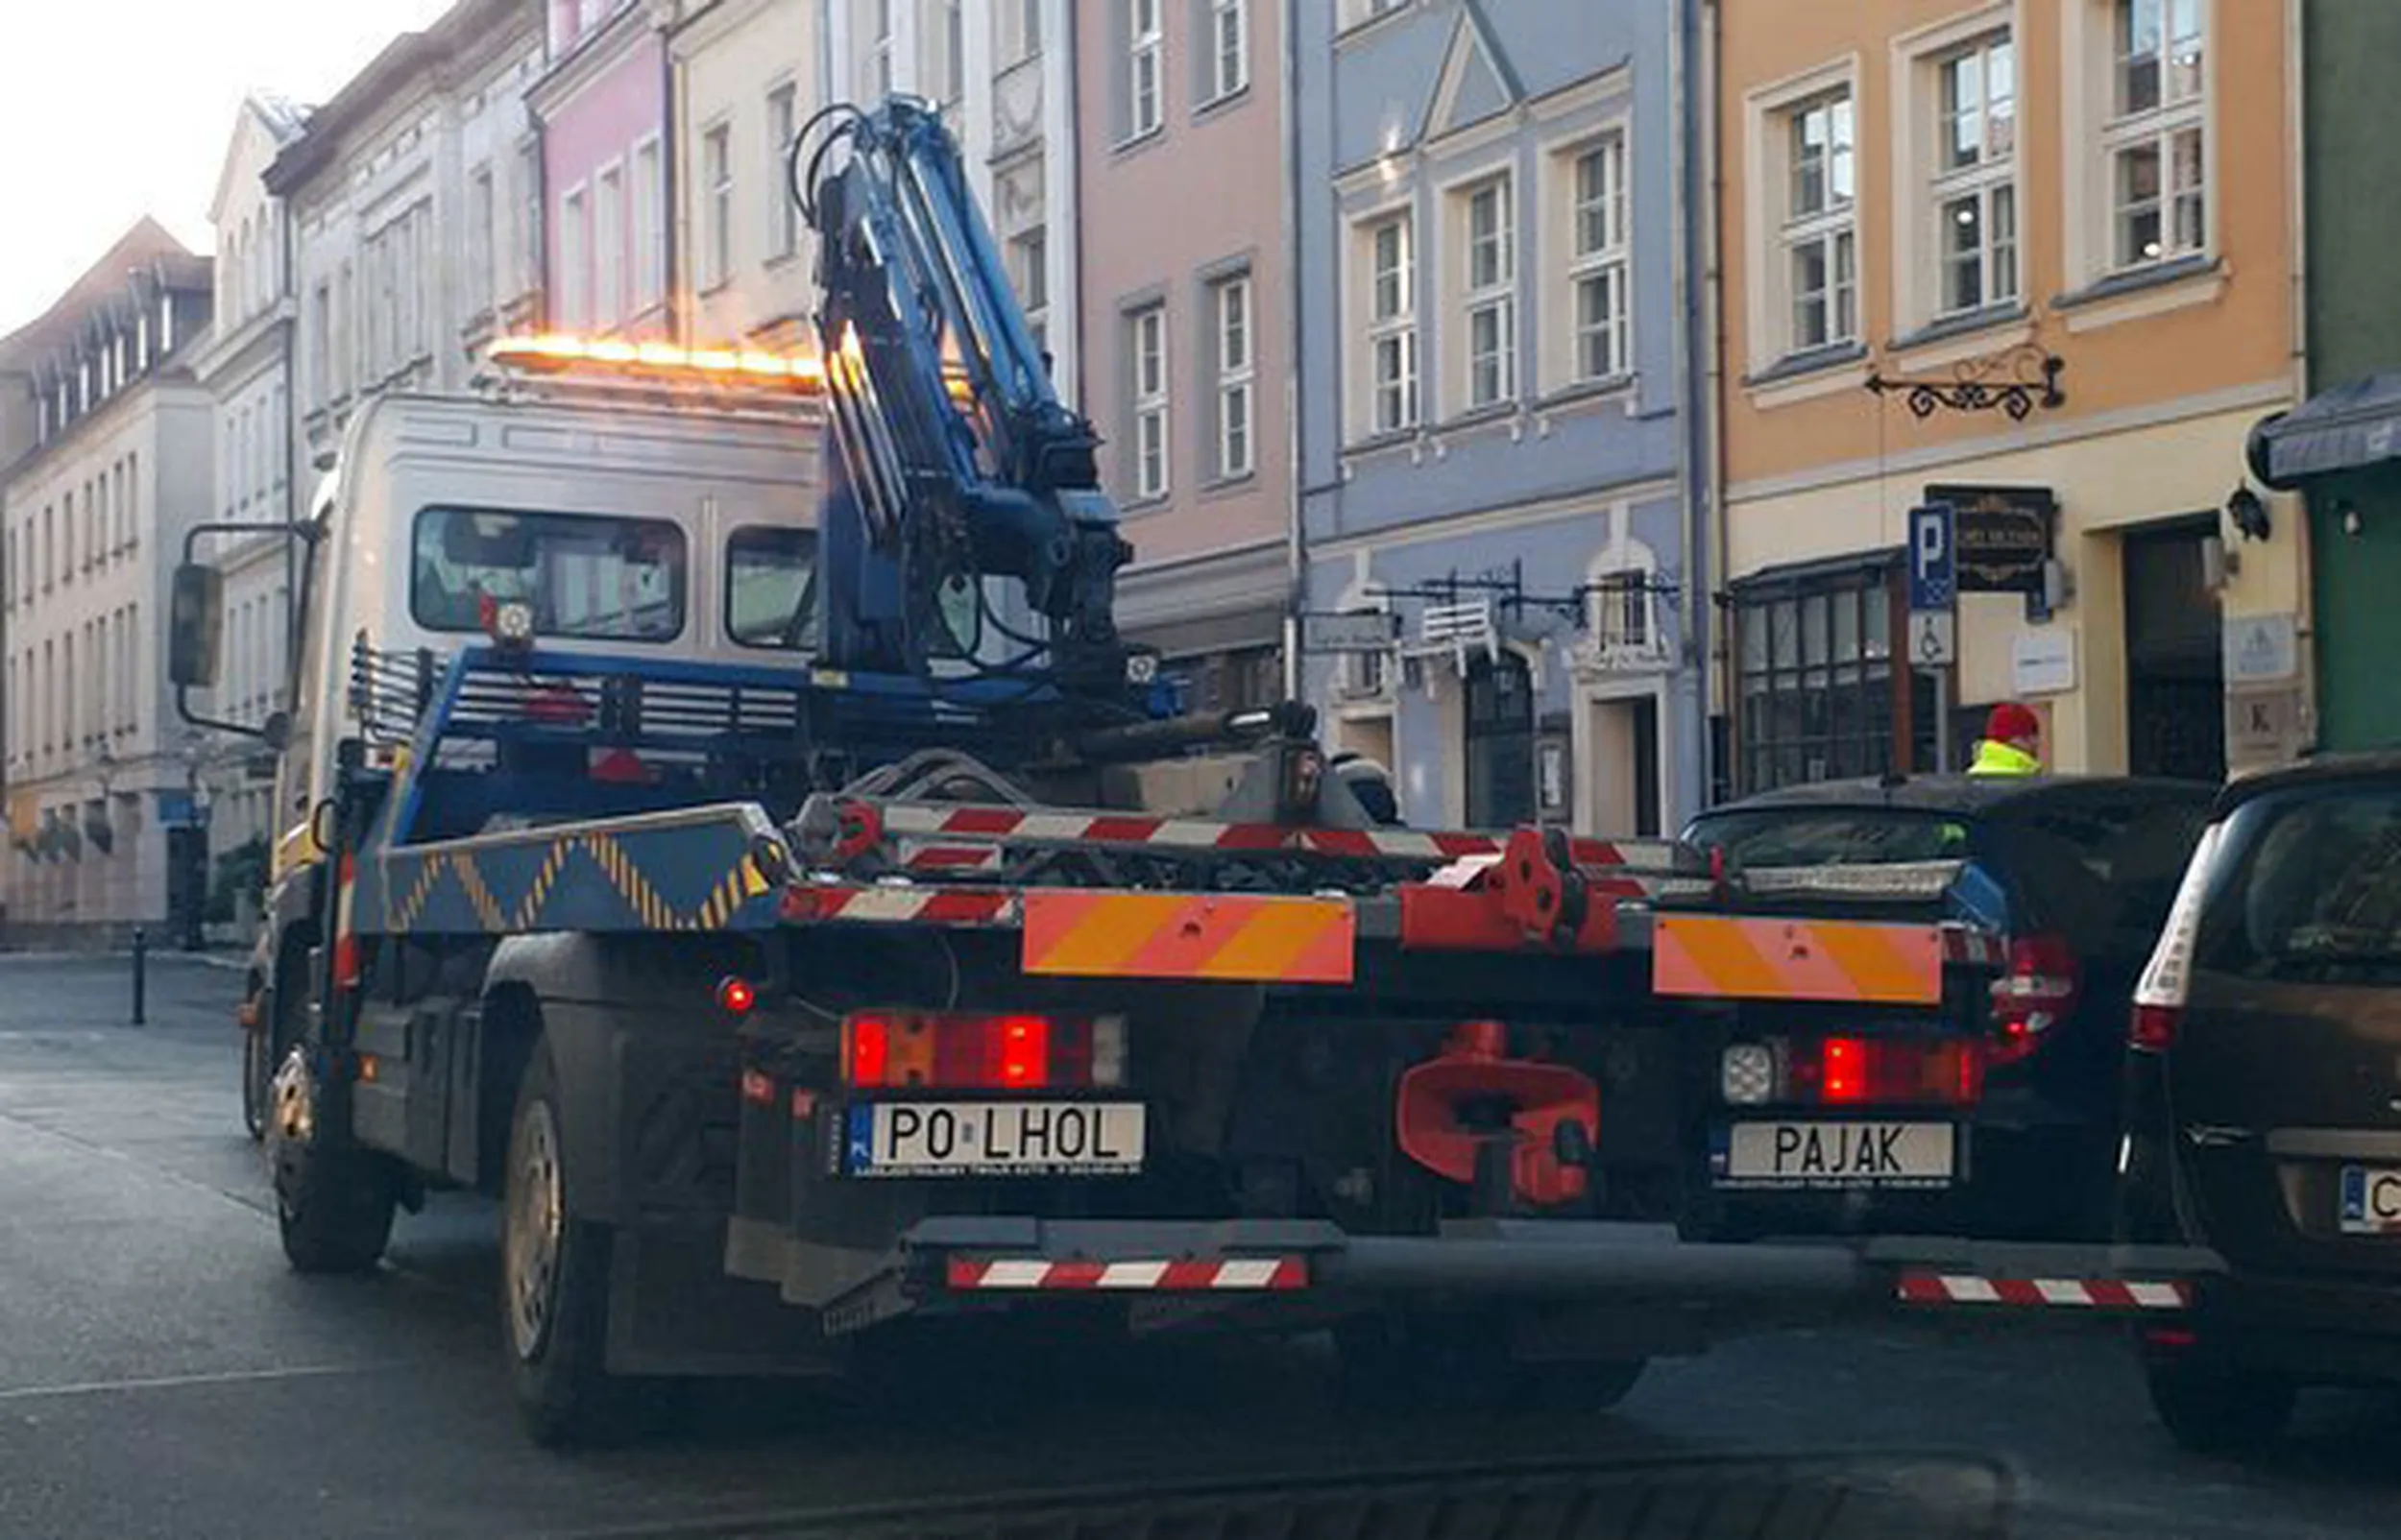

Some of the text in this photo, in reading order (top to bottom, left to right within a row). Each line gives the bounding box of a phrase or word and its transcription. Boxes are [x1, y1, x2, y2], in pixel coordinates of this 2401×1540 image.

[1918, 514, 1944, 580] P
[888, 1107, 956, 1159] PO
[982, 1107, 1120, 1159] LHOL
[1774, 1125, 1904, 1173] PAJAK
